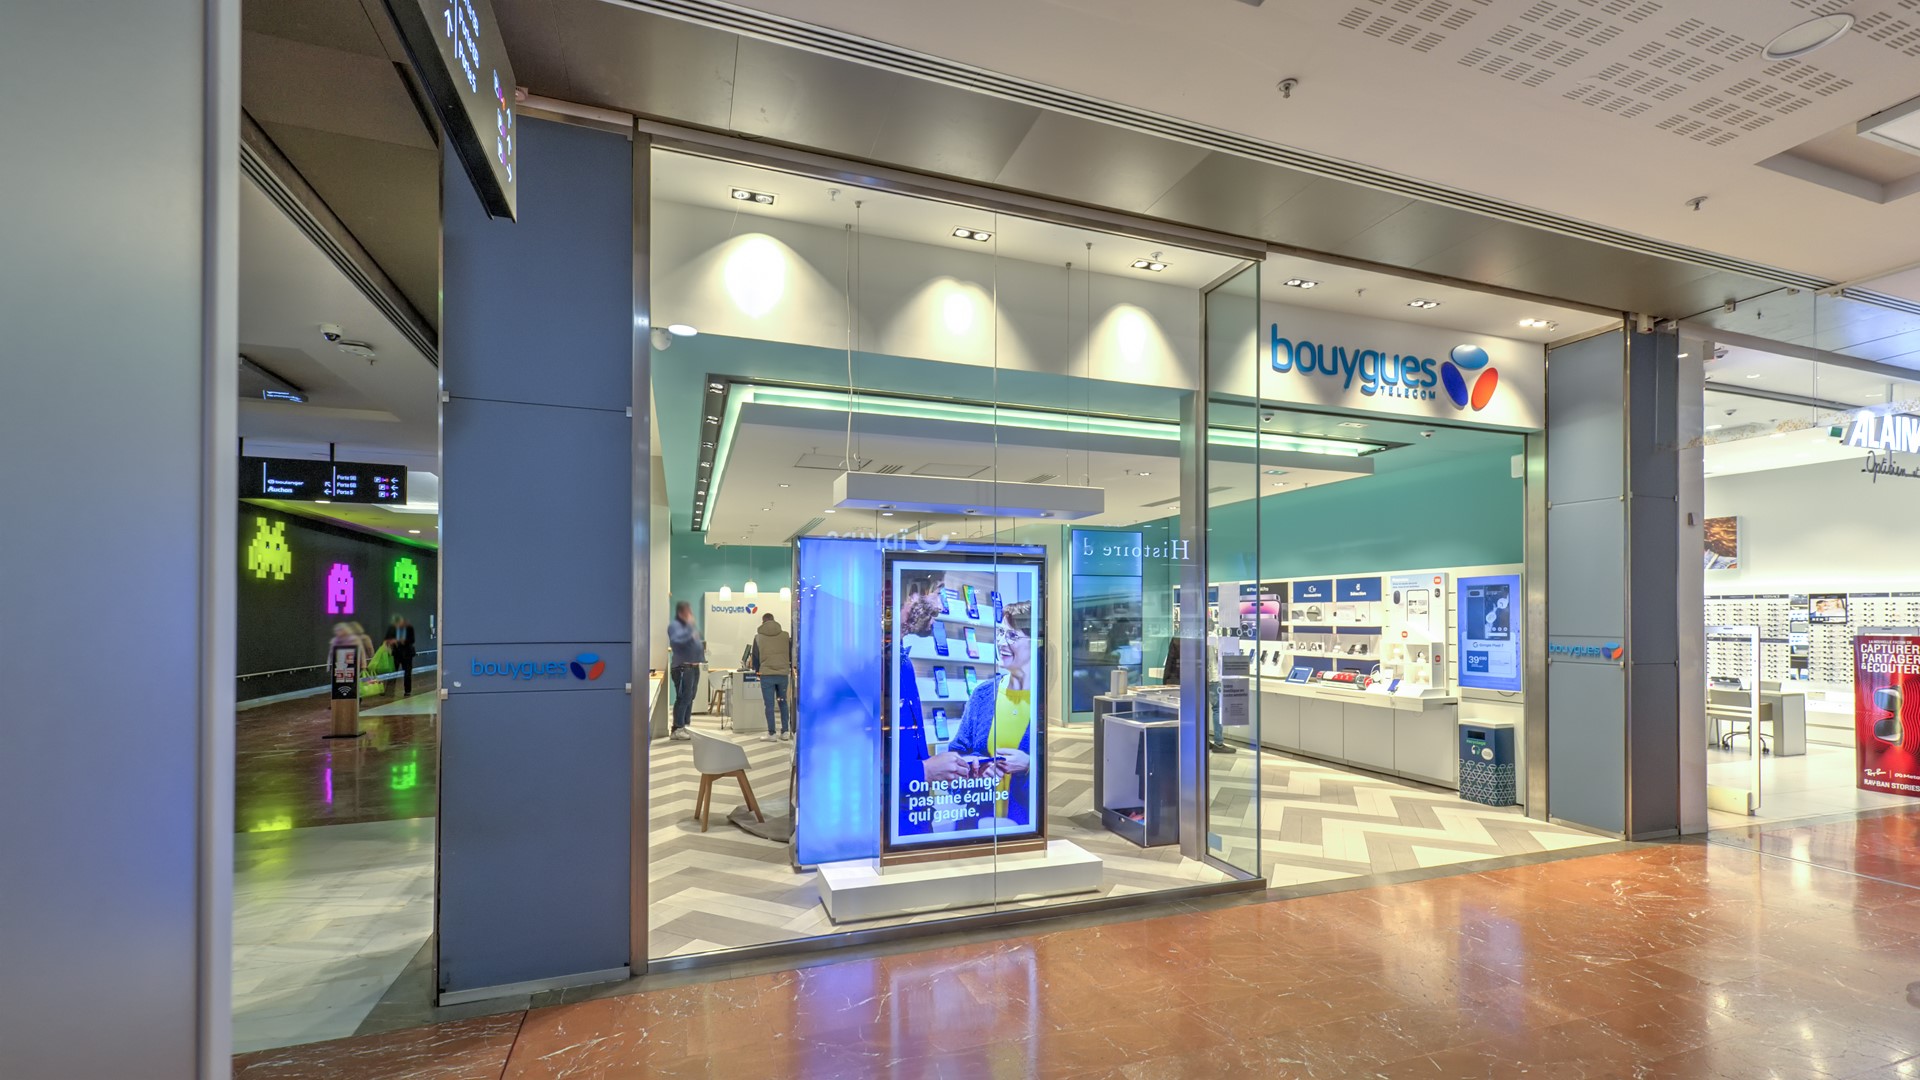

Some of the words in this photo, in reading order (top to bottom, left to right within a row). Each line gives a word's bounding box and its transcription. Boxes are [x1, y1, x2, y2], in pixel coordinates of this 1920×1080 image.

[1271, 323, 1437, 396] bouygues
[1381, 385, 1436, 400] TELECOM
[711, 604, 745, 614] bouygues
[1549, 643, 1601, 657] bouygues
[1860, 643, 1920, 655] CAPTURER
[1862, 653, 1920, 665] PARTAGER
[471, 656, 568, 680] bouygues
[909, 780, 929, 792] On
[932, 779, 949, 791] ne
[951, 776, 1000, 791] change
[909, 795, 934, 810] pas
[936, 793, 962, 805] une
[963, 789, 1009, 805] équipe
[908, 808, 931, 825] qui
[933, 806, 980, 823] gagne.
